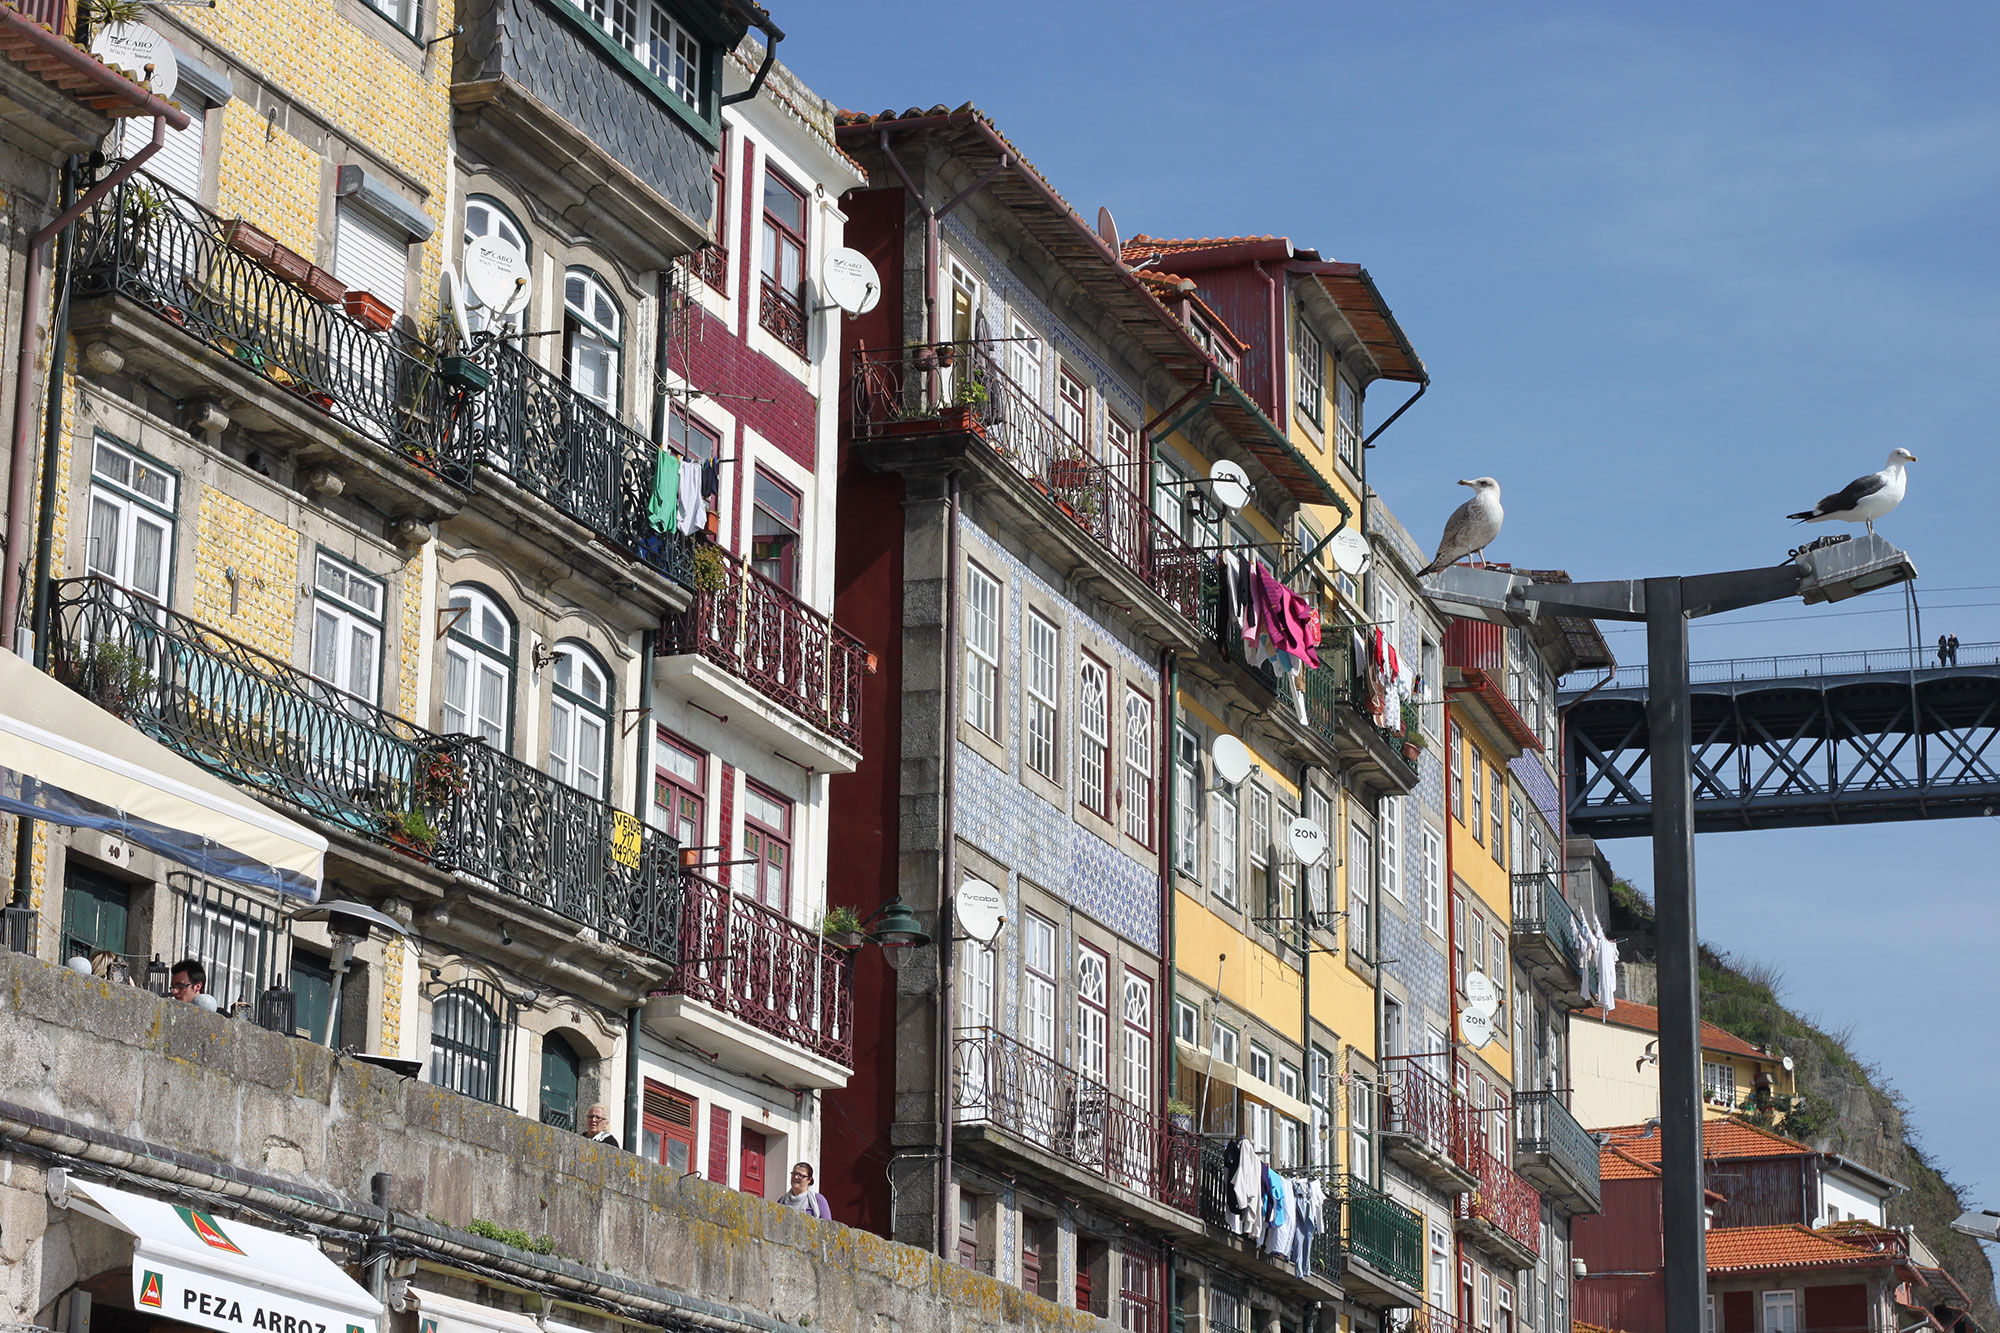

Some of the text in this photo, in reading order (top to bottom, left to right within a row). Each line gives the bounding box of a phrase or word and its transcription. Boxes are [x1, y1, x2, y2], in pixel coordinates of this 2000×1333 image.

[125, 39, 153, 49] CABO
[491, 252, 513, 264] CABO
[843, 261, 862, 270] CABO
[614, 812, 641, 836] VENDE
[621, 828, 635, 848] 917
[1294, 828, 1318, 840] ZON
[108, 844, 121, 860] 40
[613, 842, 640, 869] 149098
[1465, 1014, 1487, 1026] ZON
[183, 1288, 243, 1324] PEZA
